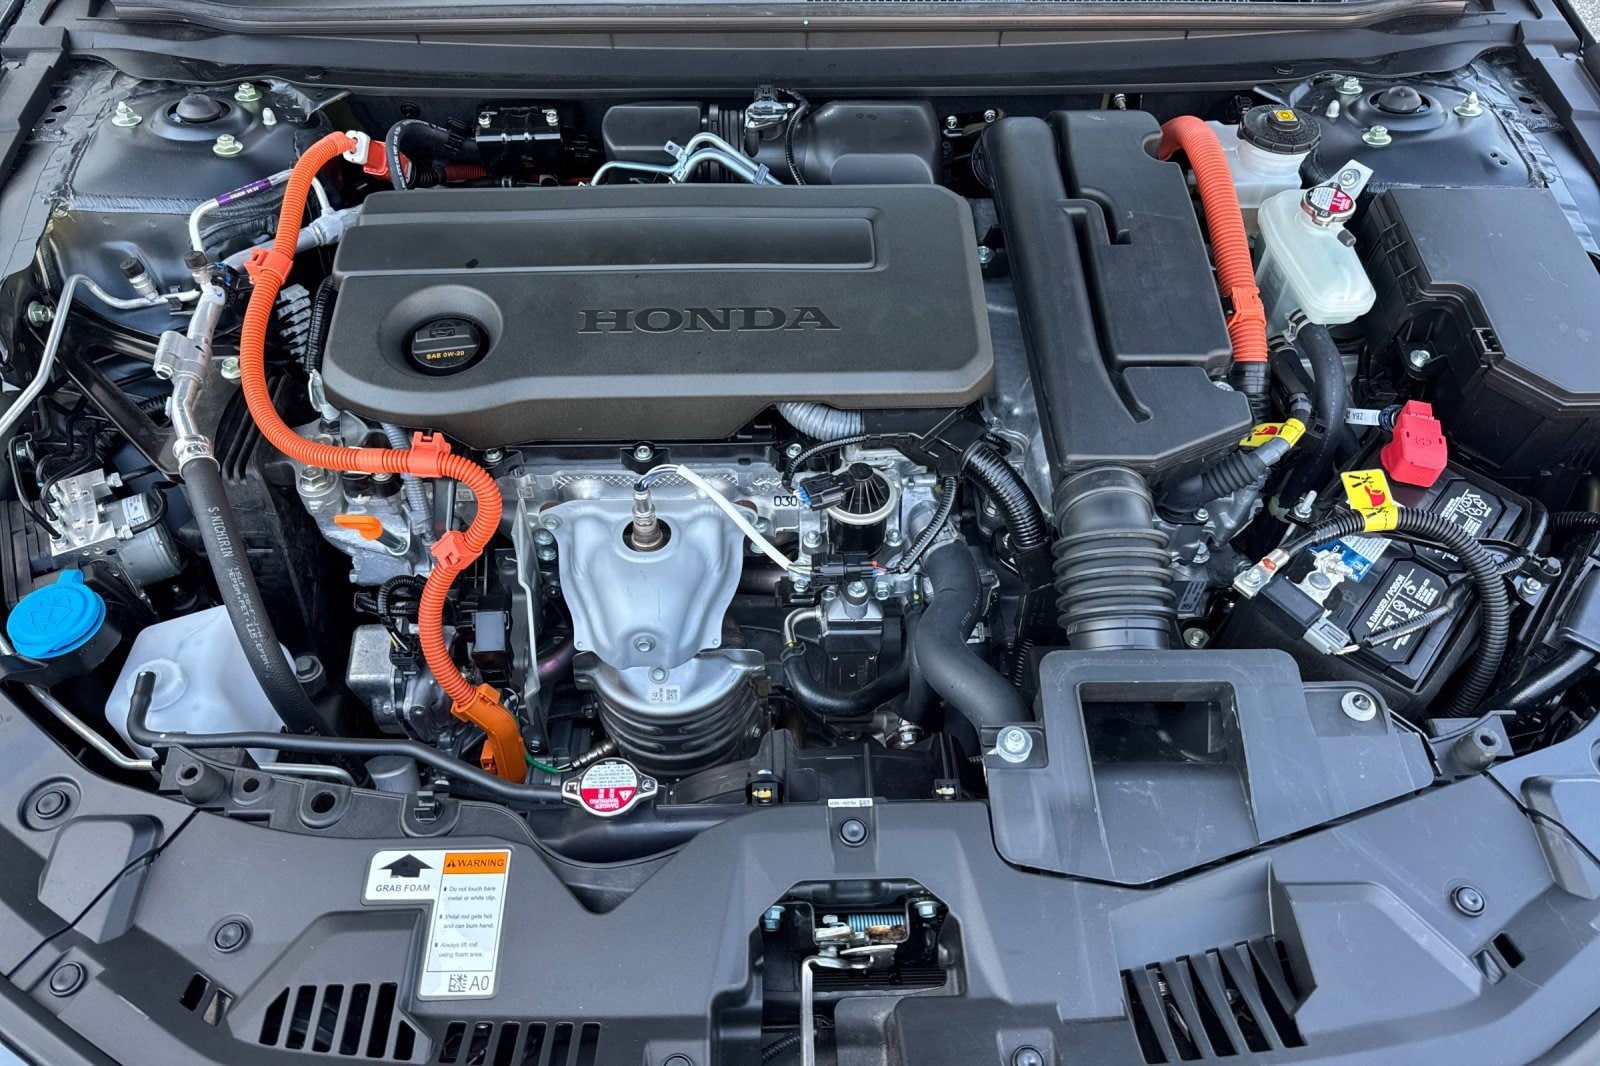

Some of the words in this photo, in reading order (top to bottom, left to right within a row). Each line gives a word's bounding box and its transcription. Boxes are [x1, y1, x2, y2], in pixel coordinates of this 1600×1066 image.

[577, 306, 841, 334] HONDA
[426, 352, 442, 360] SAE
[443, 350, 465, 358] 0W-20
[773, 495, 798, 507] 030
[1369, 598, 1389, 623] DANGER
[1387, 574, 1406, 597] POISON
[458, 859, 504, 867] WARNING
[375, 884, 402, 892] GRAB
[404, 884, 430, 892] FOAM
